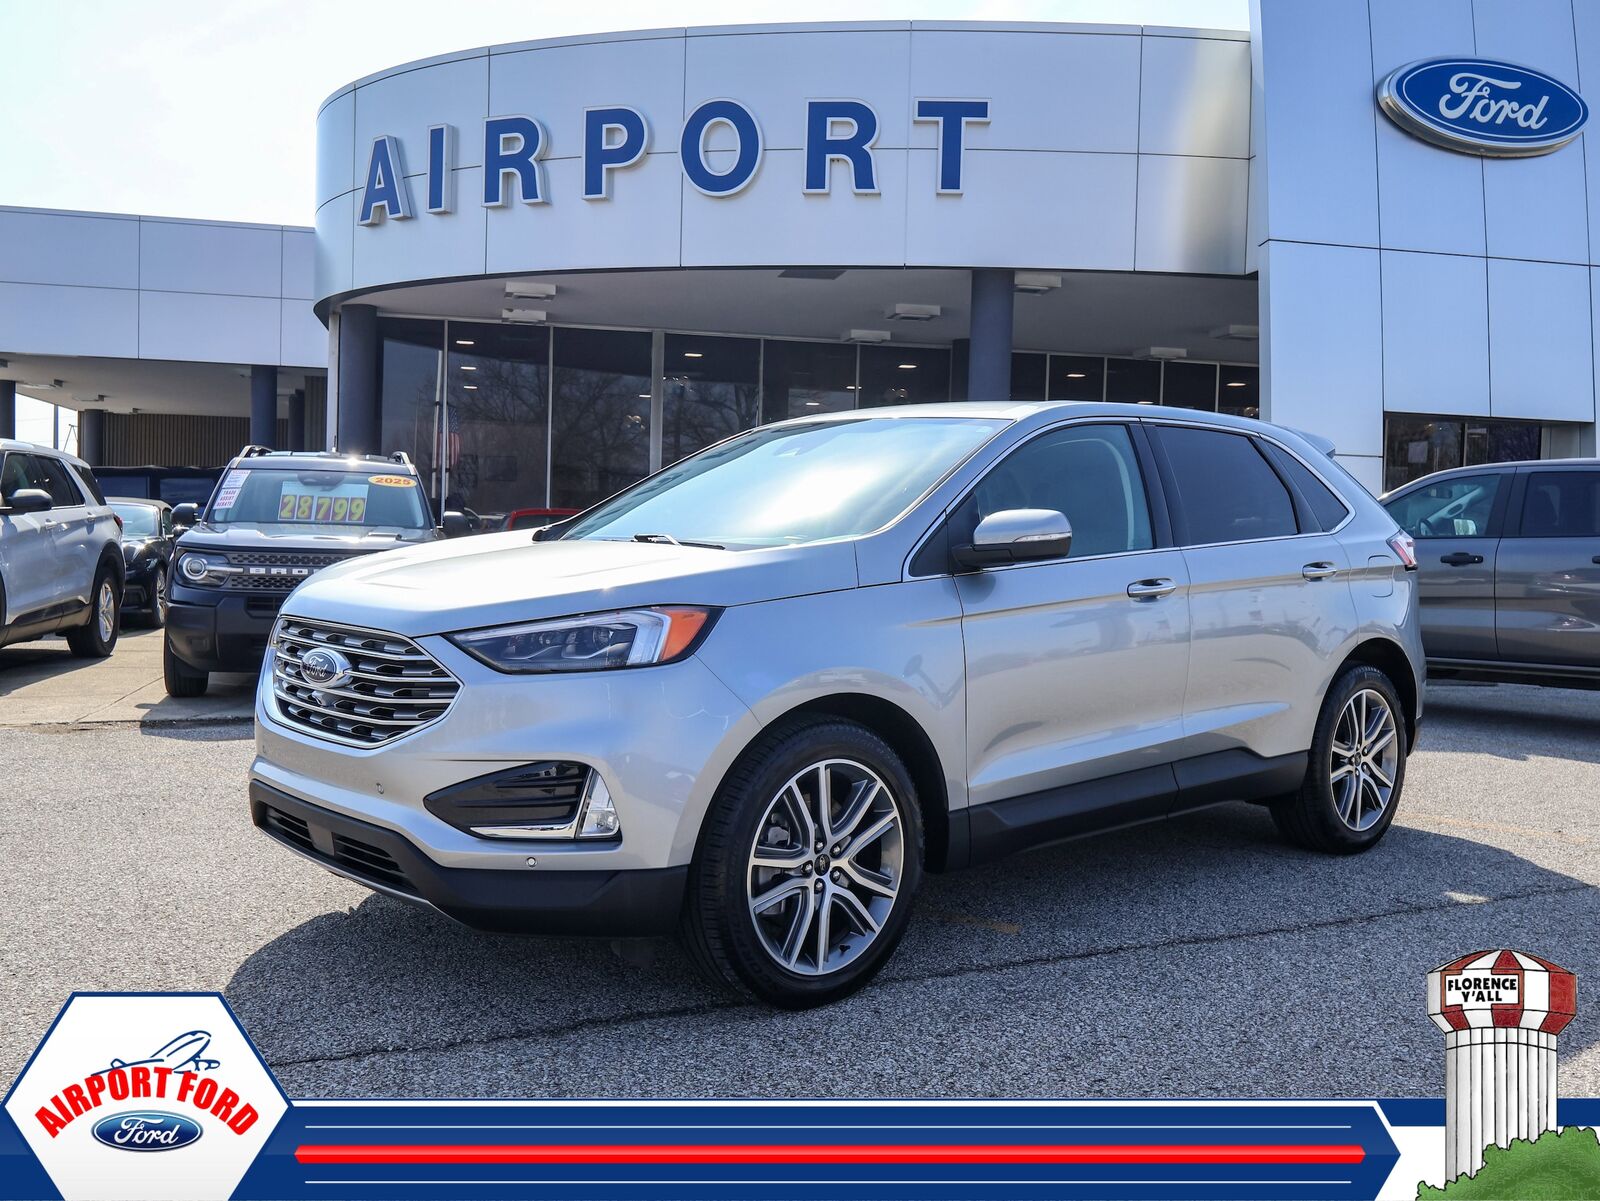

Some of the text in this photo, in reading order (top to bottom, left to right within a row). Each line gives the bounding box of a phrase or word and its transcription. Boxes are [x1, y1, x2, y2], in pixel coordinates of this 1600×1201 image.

[1439, 73, 1550, 129] Ford
[357, 96, 992, 227] AIRPORT
[375, 477, 411, 486] 2025
[280, 495, 364, 521] 28799
[305, 656, 327, 678] Ford
